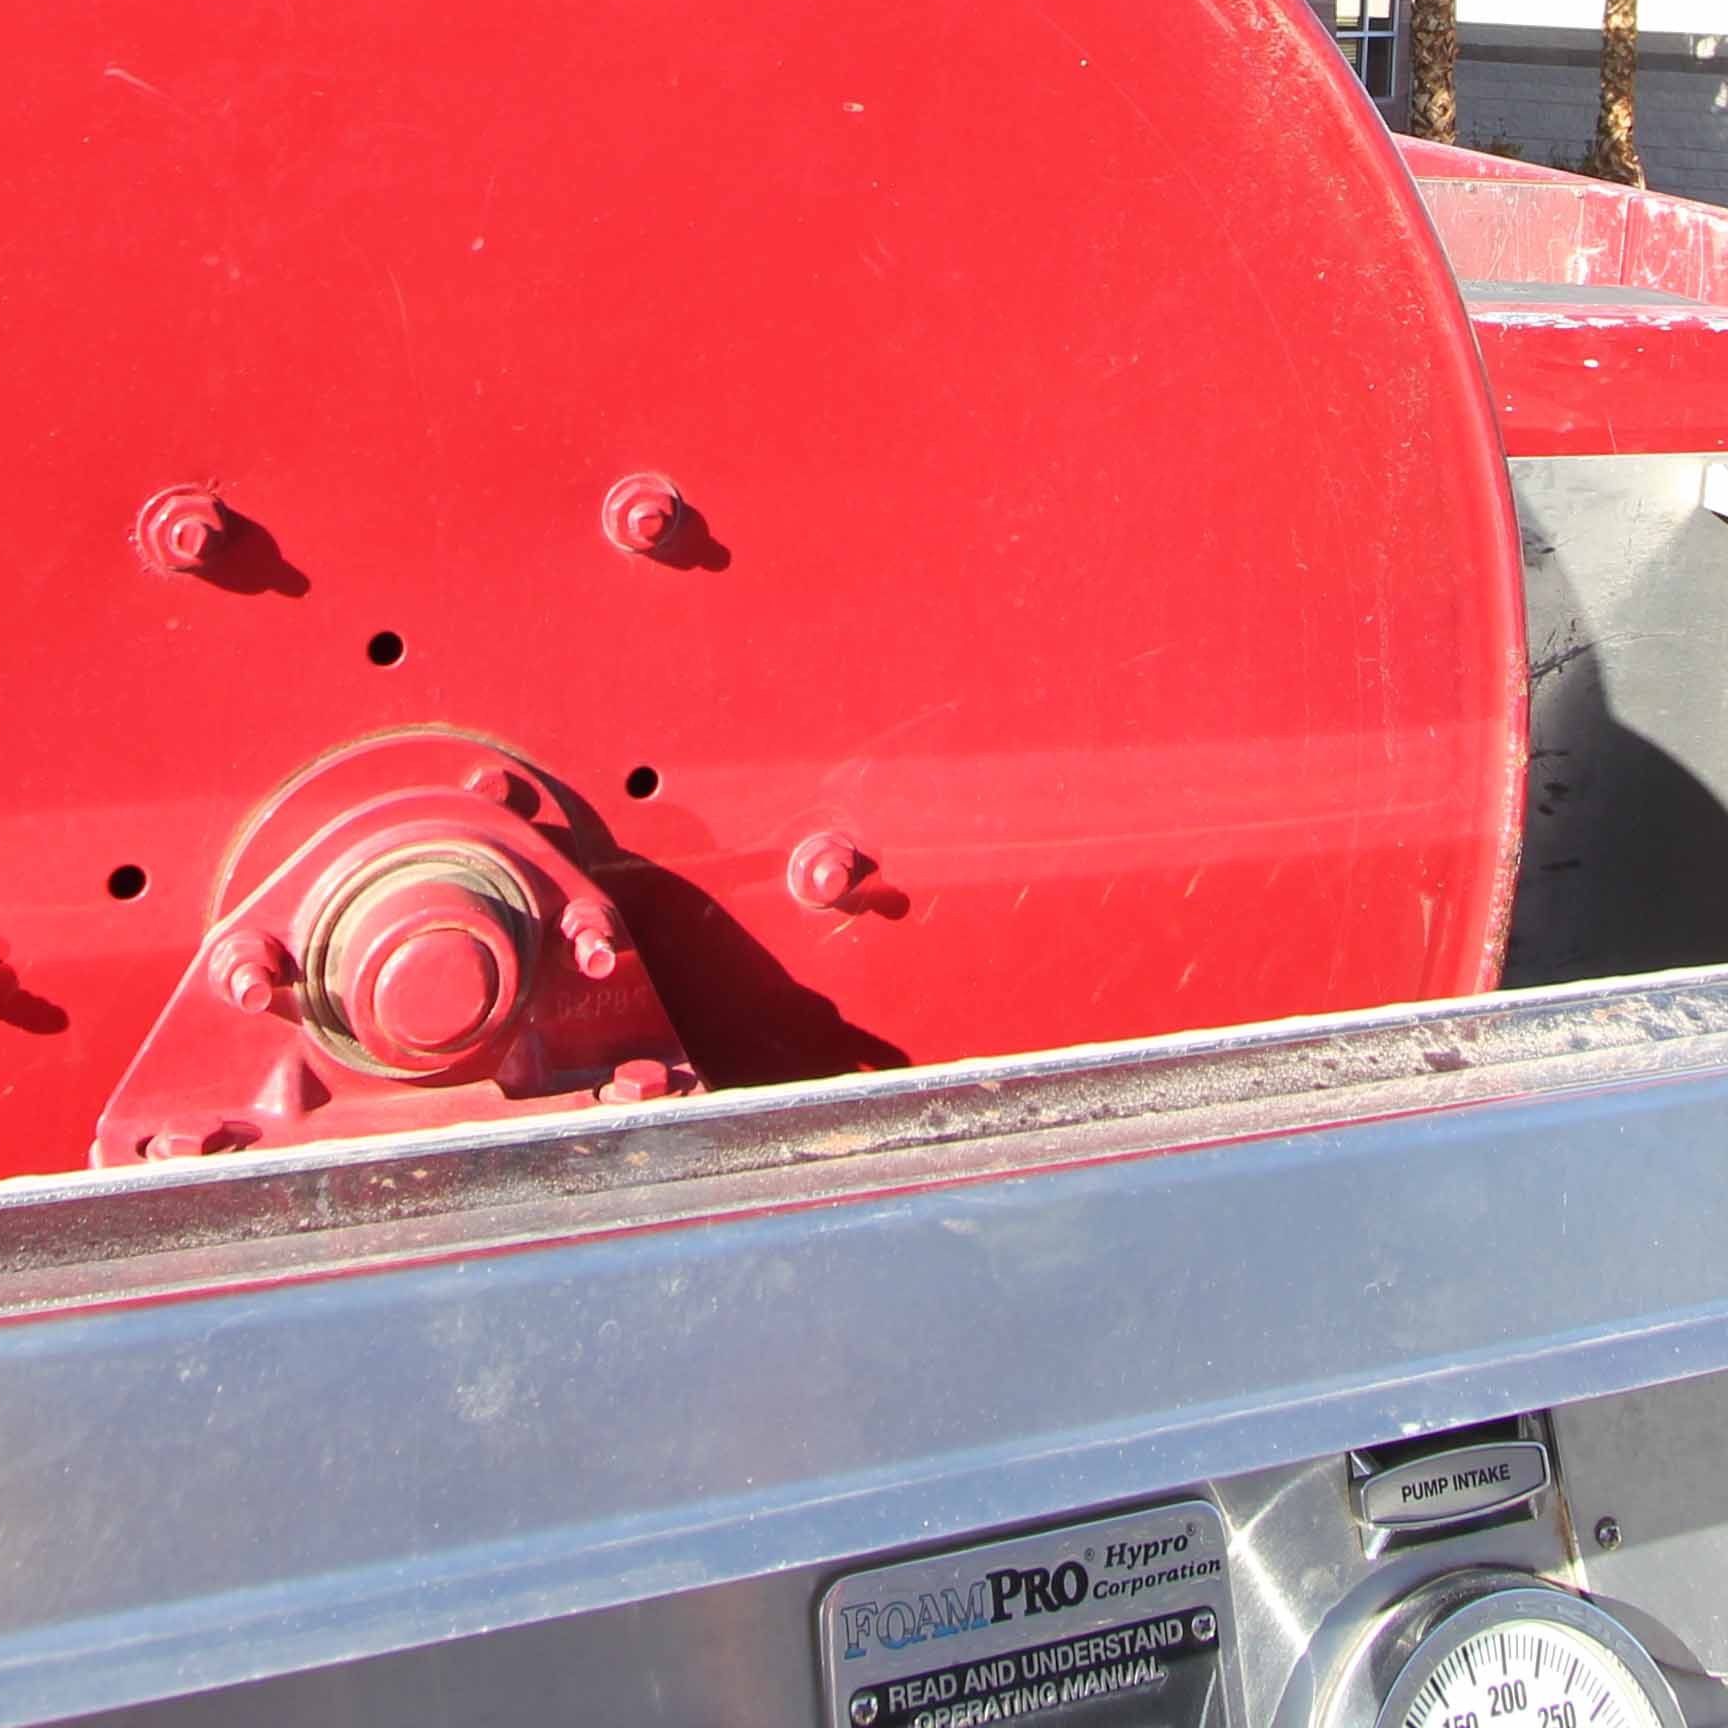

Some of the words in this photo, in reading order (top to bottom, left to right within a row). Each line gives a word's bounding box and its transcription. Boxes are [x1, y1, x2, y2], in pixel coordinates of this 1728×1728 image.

[1401, 1477, 1449, 1503] PUMP
[1452, 1463, 1512, 1492] INTAKE
[1103, 1531, 1190, 1570] Hypro
[1092, 1557, 1222, 1601] Corporation
[888, 1673, 958, 1713] READ
[963, 1659, 1016, 1695] AND
[1021, 1618, 1184, 1680] UNDERSTAND
[913, 1680, 1059, 1728] OPERATING
[1487, 1679, 1528, 1718] 200
